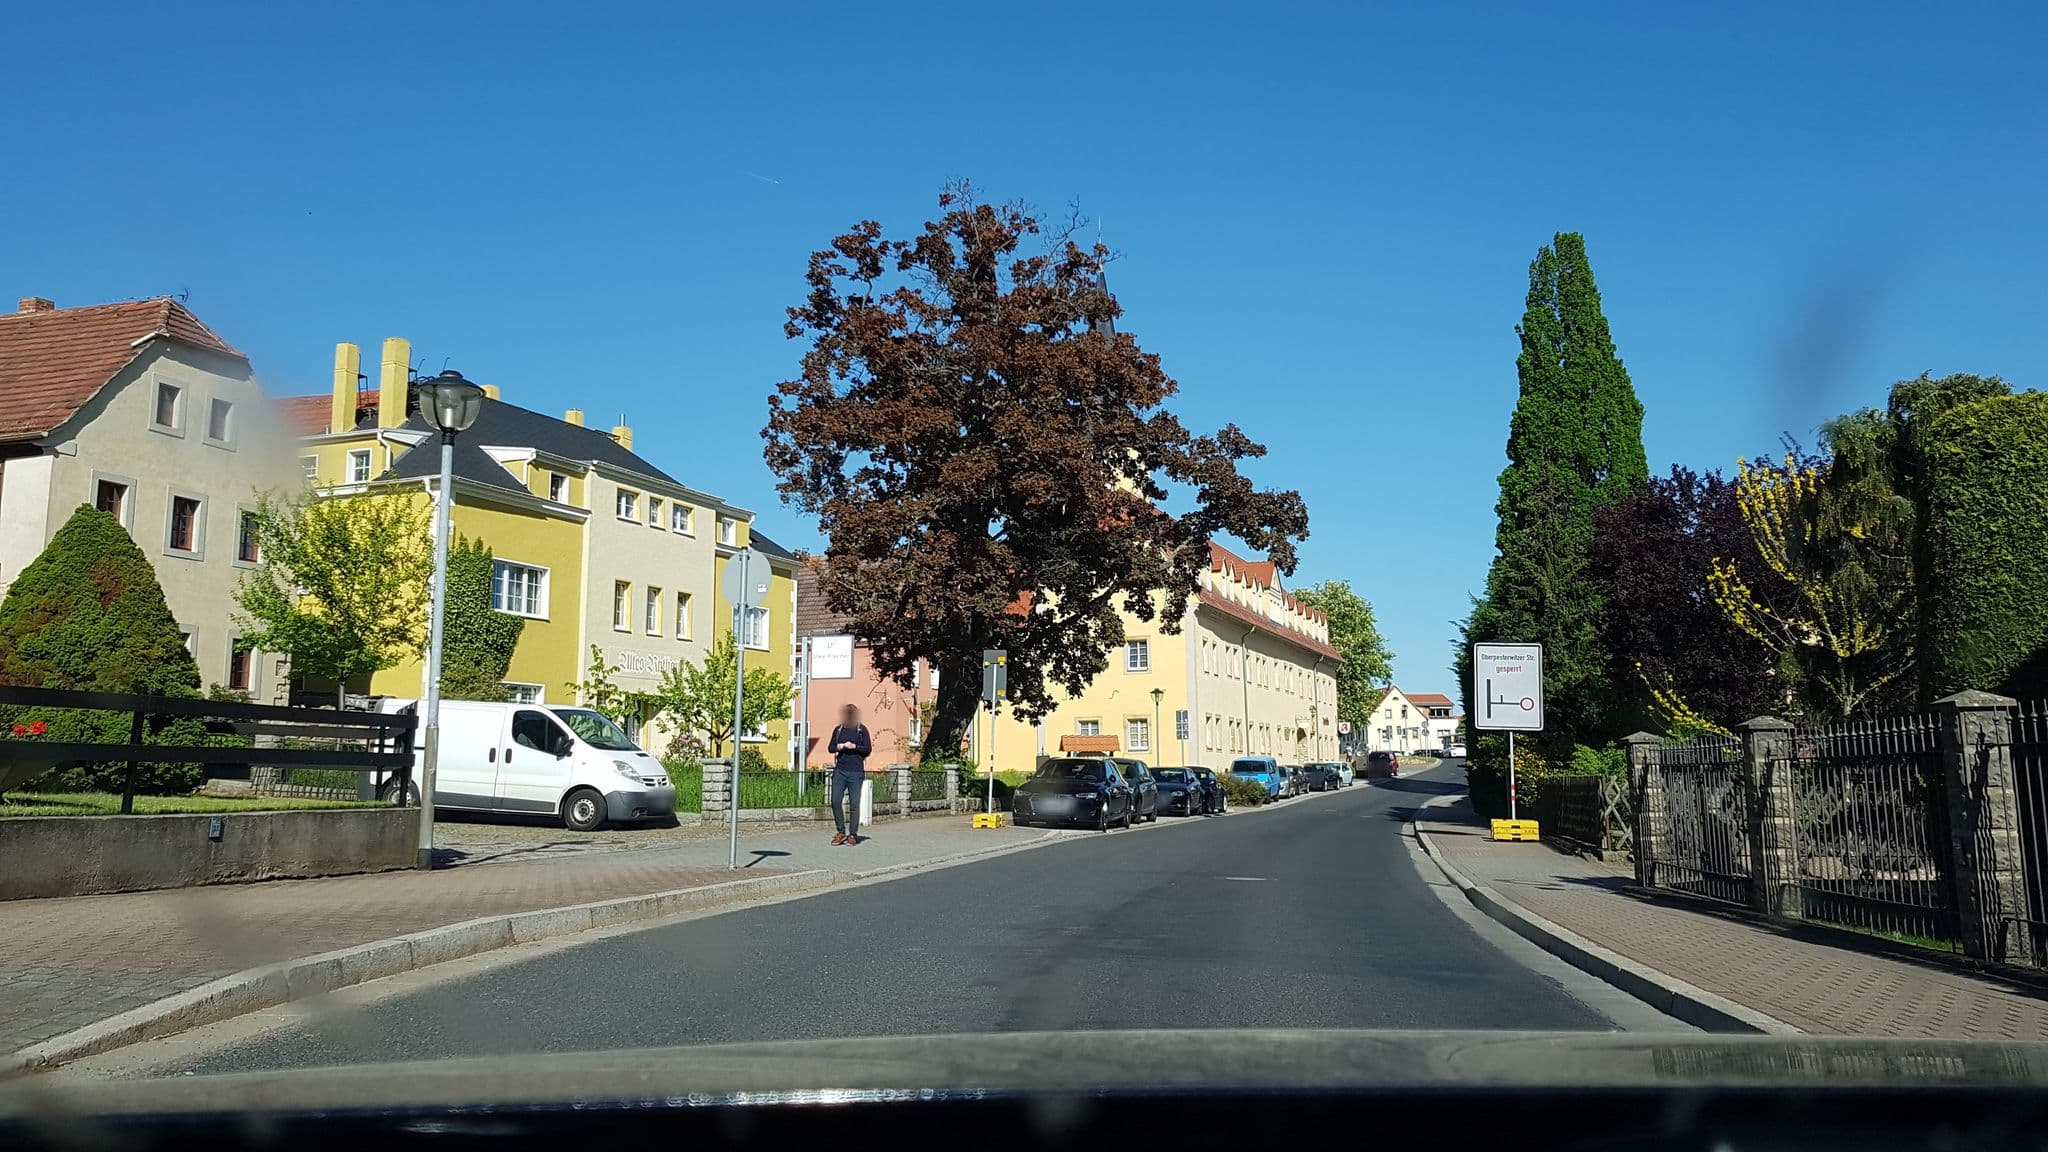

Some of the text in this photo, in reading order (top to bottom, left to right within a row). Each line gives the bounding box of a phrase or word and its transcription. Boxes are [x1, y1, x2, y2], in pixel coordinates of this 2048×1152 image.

[1481, 653, 1525, 661] Oberpesterwitzer
[619, 651, 687, 677] Altes Ratha
[1495, 665, 1522, 674] gesperrt
